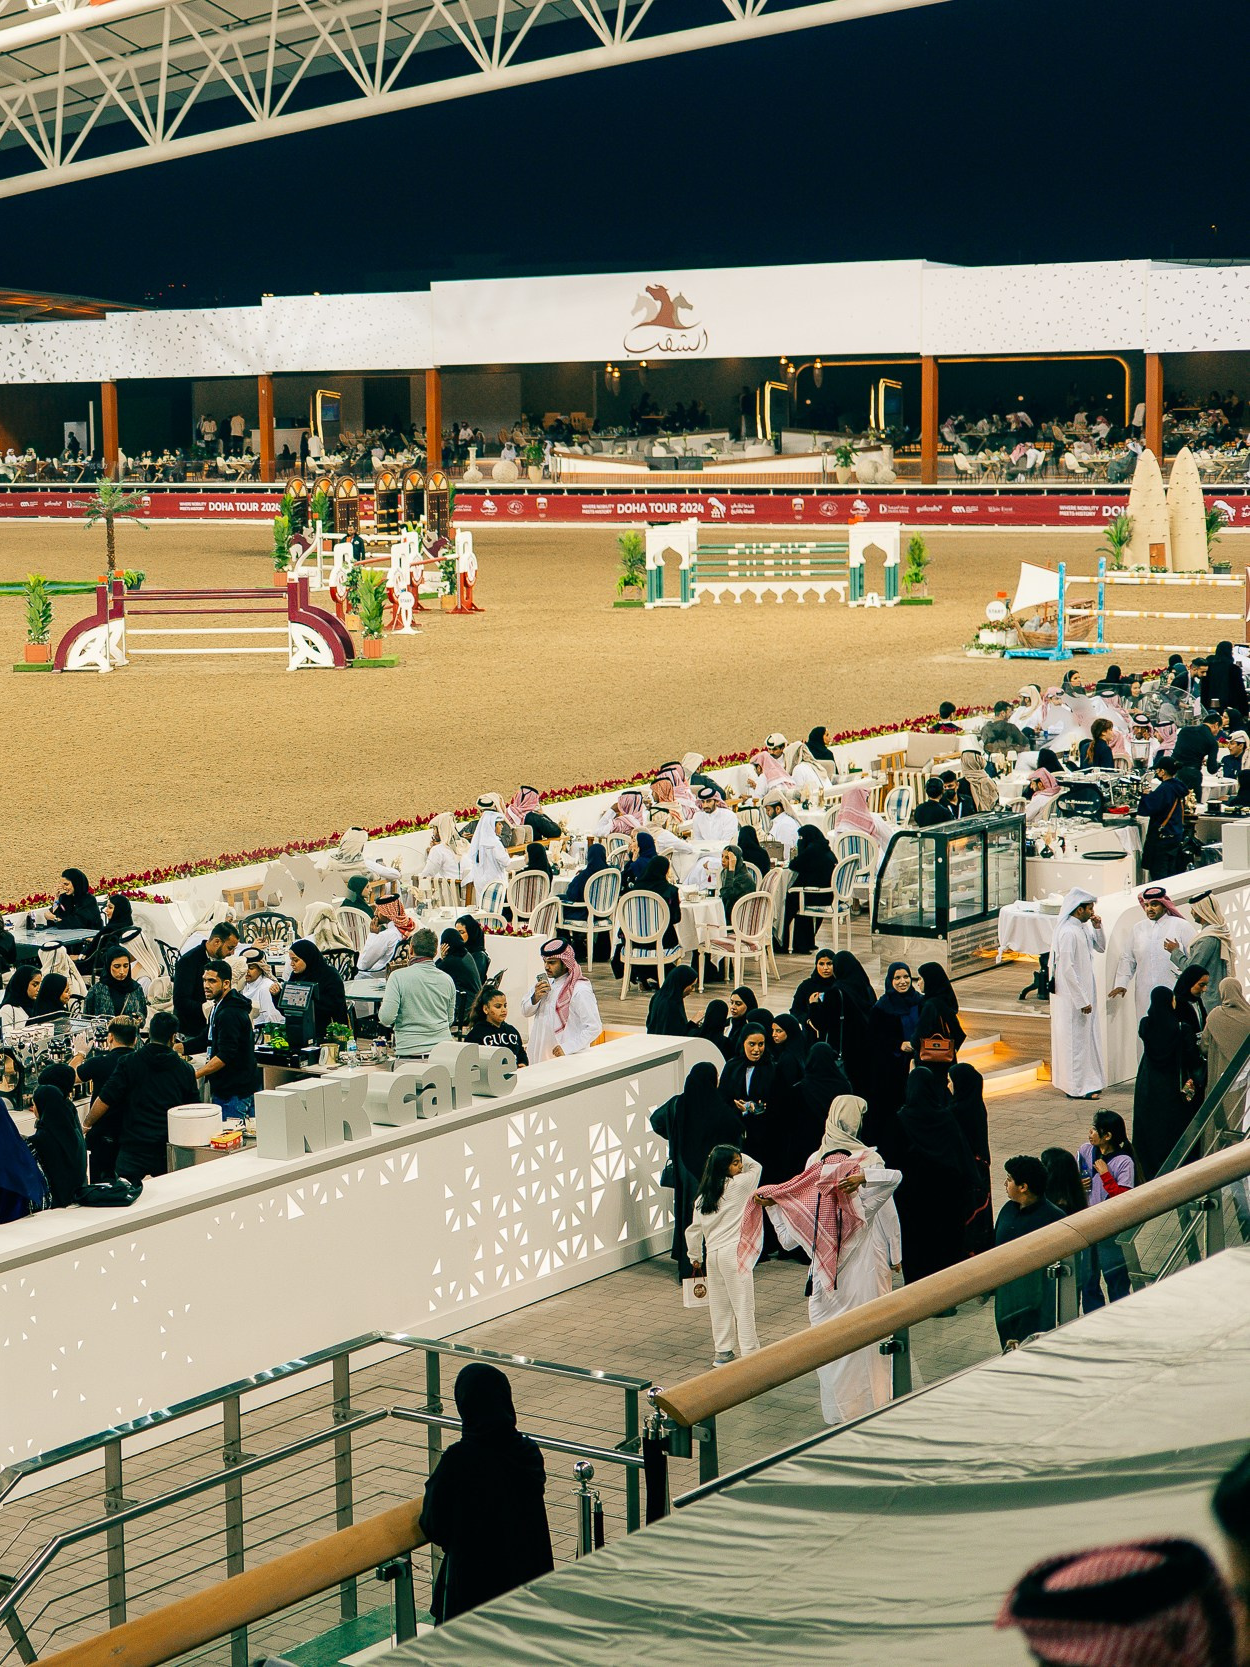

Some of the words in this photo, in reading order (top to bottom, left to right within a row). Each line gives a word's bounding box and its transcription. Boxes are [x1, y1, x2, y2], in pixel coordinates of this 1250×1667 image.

[209, 502, 234, 511] DOHA
[235, 502, 258, 511] TOUR
[260, 503, 280, 512] 2024
[617, 503, 648, 514] DOHA
[649, 503, 678, 513] TOUR
[680, 503, 704, 513] 2024
